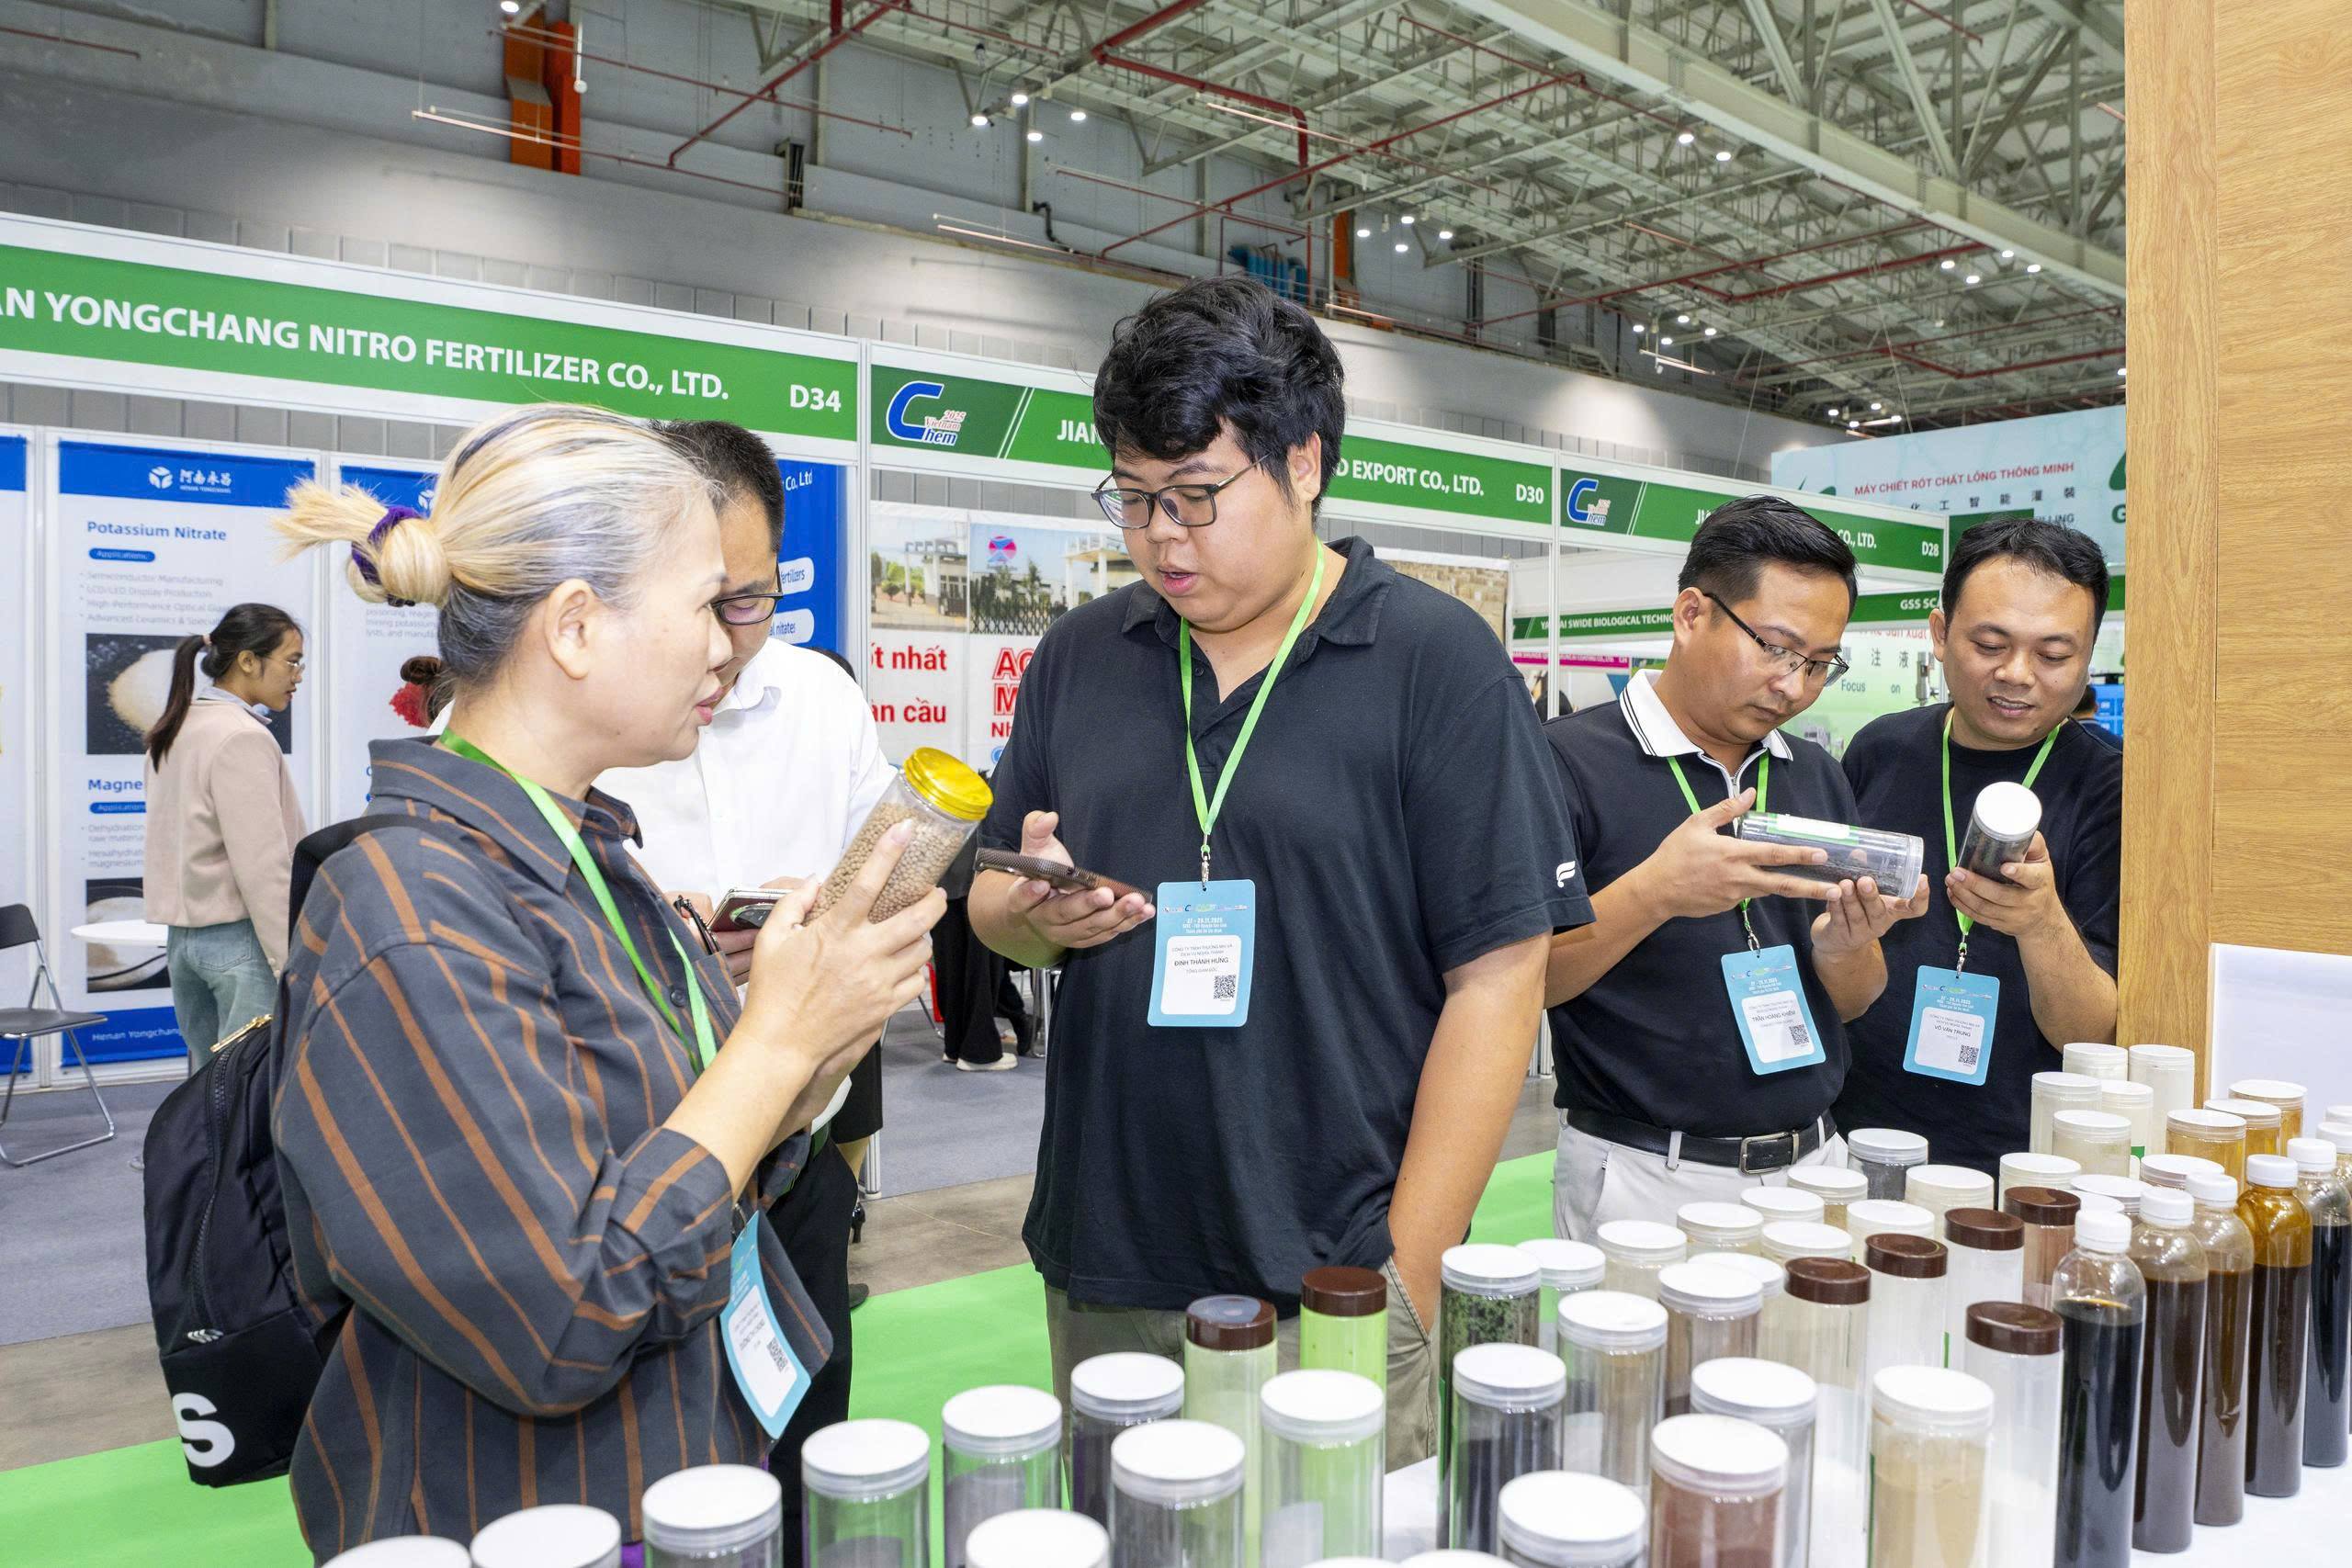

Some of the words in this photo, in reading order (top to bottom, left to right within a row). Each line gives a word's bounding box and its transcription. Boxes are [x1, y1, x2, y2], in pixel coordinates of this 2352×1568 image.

[44, 291, 300, 349] YONGCHANG
[309, 324, 417, 363] NITRO
[425, 338, 600, 385] FERTILIZER
[607, 366, 663, 396] CO.,
[672, 370, 729, 400] LTD.
[789, 384, 842, 412] D34
[925, 416, 961, 432] Vietnam
[2042, 462, 2075, 474] MINH
[1352, 460, 1417, 486] EXPORT
[1419, 470, 1449, 494] CO.,
[1453, 474, 1485, 496] LTD.
[1516, 483, 1544, 504] D30
[87, 521, 170, 537] Potassium
[175, 526, 227, 540] Nitrate
[1857, 532, 1877, 548] LTD.
[1921, 540, 1939, 558] D28
[1900, 599, 1921, 610] GSS
[1923, 598, 1939, 609] SC
[1568, 617, 1593, 628] SWIDE
[1594, 615, 1641, 627] BIOLOGICAL
[892, 645, 947, 671] nhất
[1841, 681, 1866, 693] Focus
[1891, 684, 1901, 694] on
[903, 696, 947, 724] cầu
[88, 779, 143, 793] Magne
